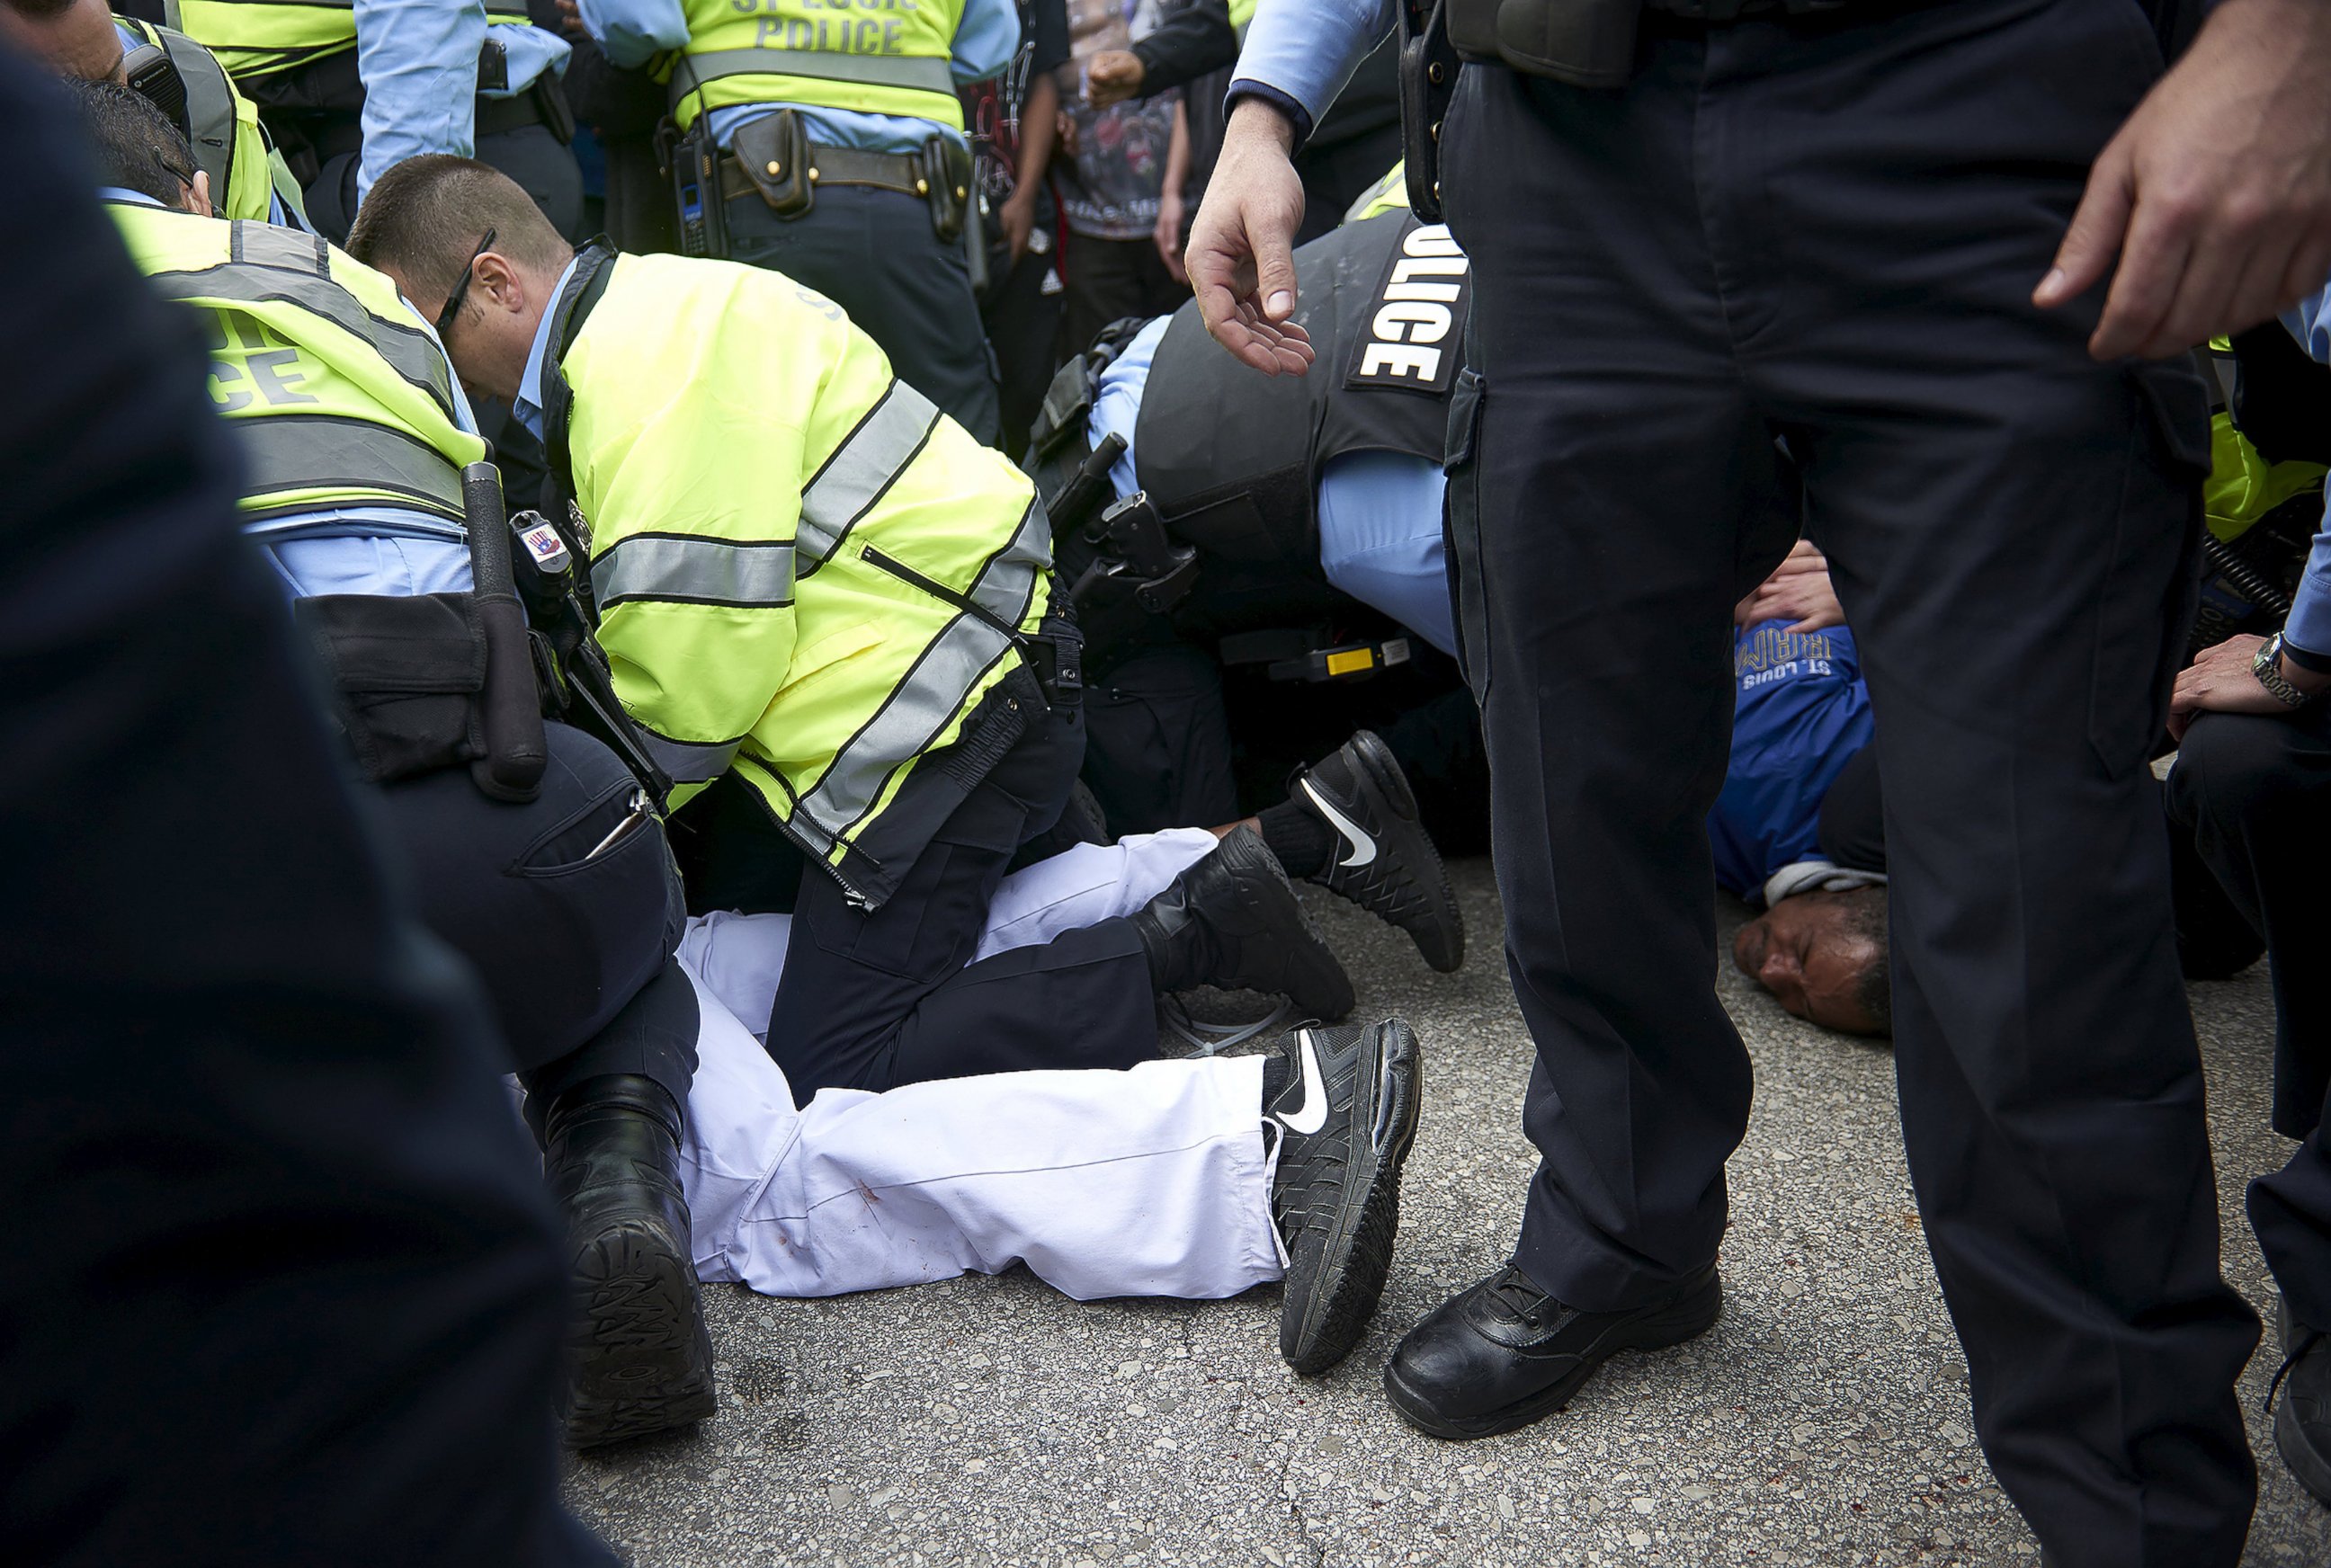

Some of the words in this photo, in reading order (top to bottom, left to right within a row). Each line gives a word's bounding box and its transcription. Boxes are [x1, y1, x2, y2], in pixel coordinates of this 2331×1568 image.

[755, 16, 904, 54] POLICE
[1359, 224, 1469, 382] OLICE
[1735, 628, 1832, 678] RAM
[1800, 658, 1832, 676] ST.
[1742, 661, 1798, 690] LOUIS
